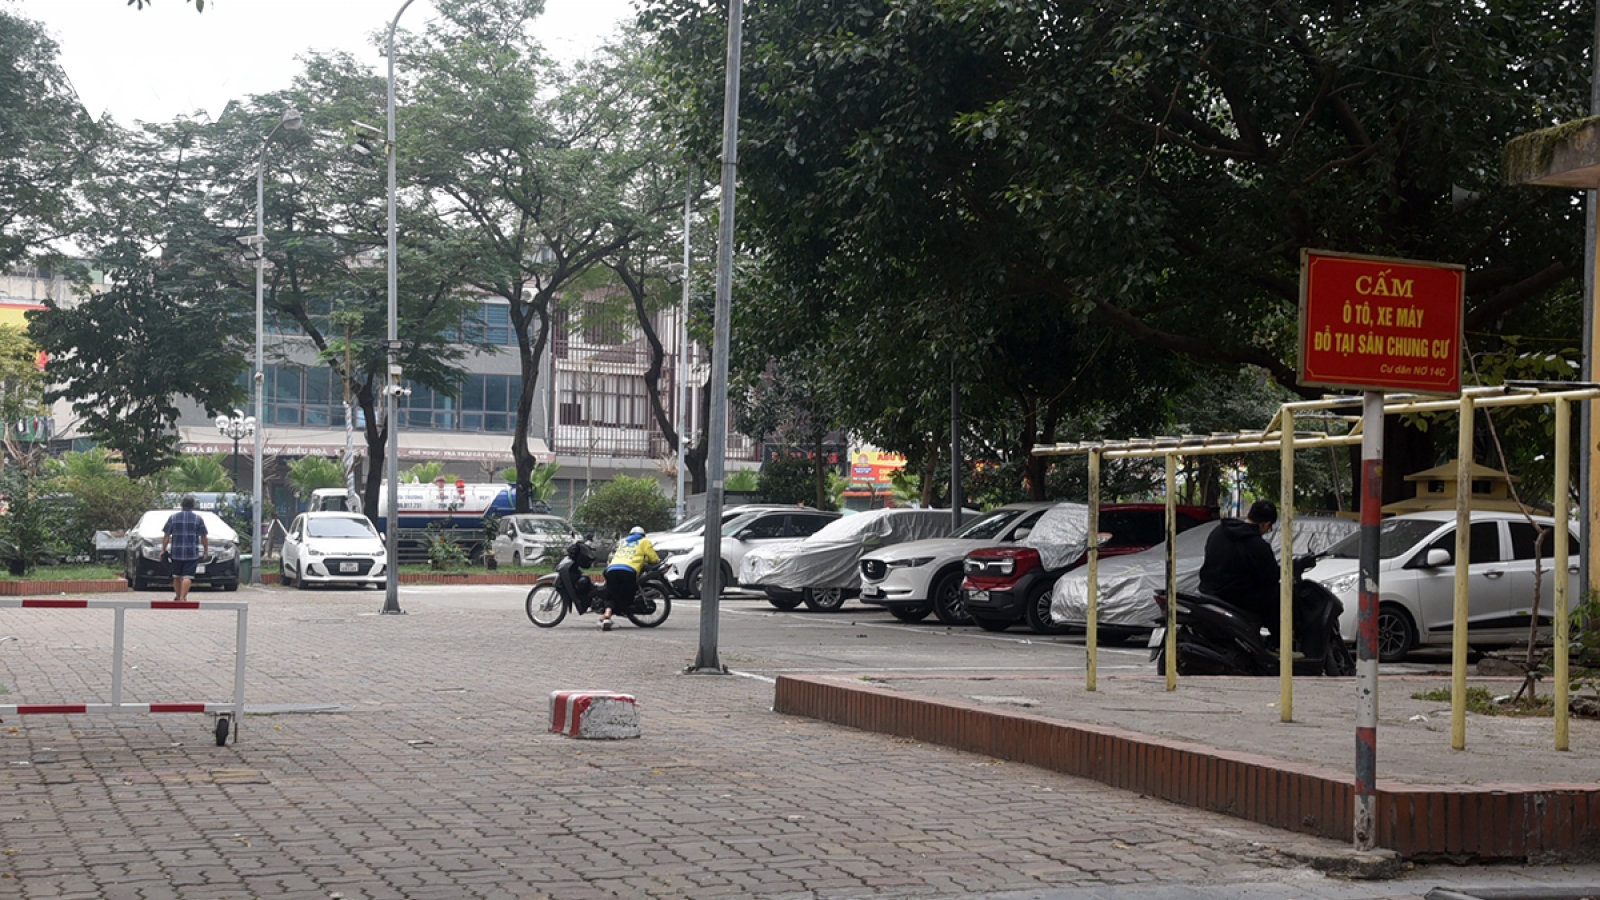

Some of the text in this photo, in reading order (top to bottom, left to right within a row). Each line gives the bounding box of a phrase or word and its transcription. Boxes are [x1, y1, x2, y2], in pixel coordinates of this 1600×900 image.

[1355, 268, 1414, 298] CẤM
[1343, 300, 1424, 328] Ô TÔ, XE MÁY
[1314, 325, 1451, 359] ĐỖ TẠI SÂN CHUNG CƯ
[1380, 363, 1393, 373] Cư
[1394, 364, 1412, 374] dân
[1430, 367, 1447, 377] 14C
